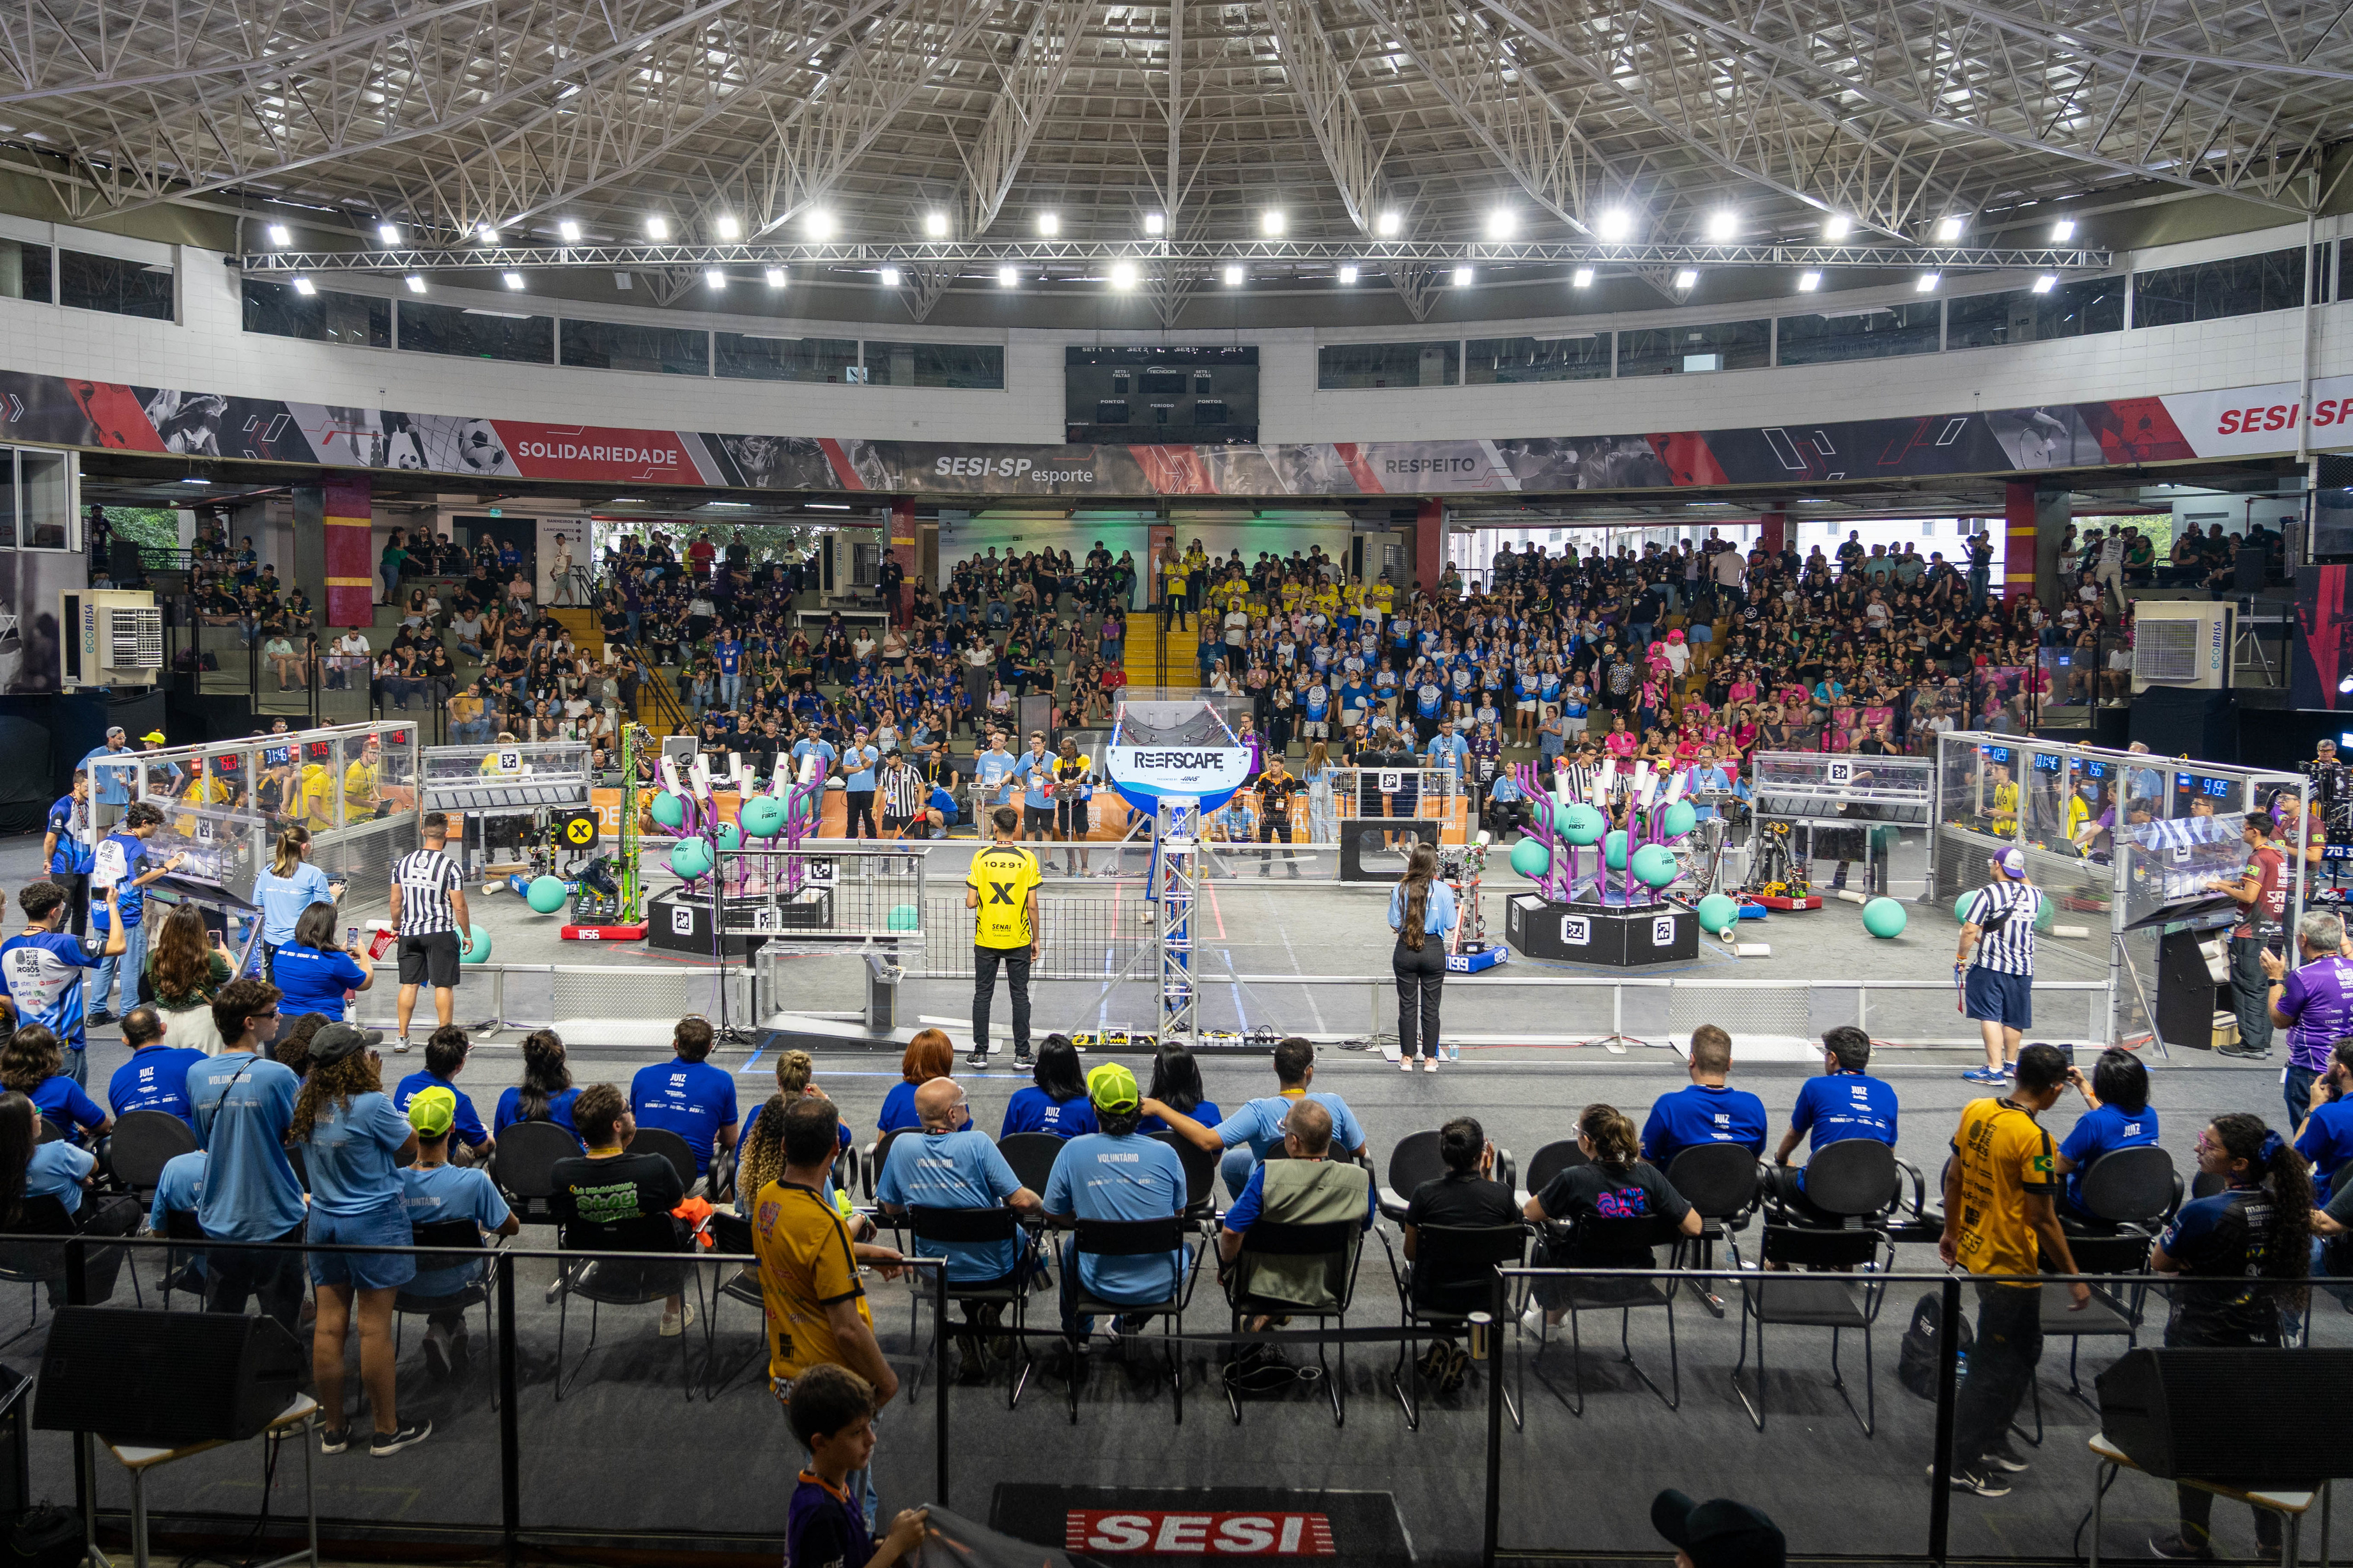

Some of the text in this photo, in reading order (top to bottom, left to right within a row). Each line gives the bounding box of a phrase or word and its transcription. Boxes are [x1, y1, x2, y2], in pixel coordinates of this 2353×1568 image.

[518, 441, 677, 465] SOLIDARIEDADE
[935, 457, 1093, 485] SESI-SP esporte
[1385, 458, 1475, 474] RESPEITO
[1134, 752, 1224, 769] REEFSCAPE
[1793, 899, 1806, 910] 9175
[1729, 916, 1738, 924] FIRST
[578, 930, 599, 940] 1156
[1445, 956, 1469, 971] 199
[139, 1066, 154, 1078] JUIZ
[670, 1073, 687, 1082] JUIZ
[1851, 1086, 1868, 1095] JUIZ
[1044, 1106, 1060, 1117] JUIZ
[1714, 1113, 1730, 1124] JUIZ
[2123, 1123, 2141, 1137] JUIZ
[1097, 1153, 1139, 1163] VOLUNTÁRIO
[1087, 1515, 1303, 1552] SESI
